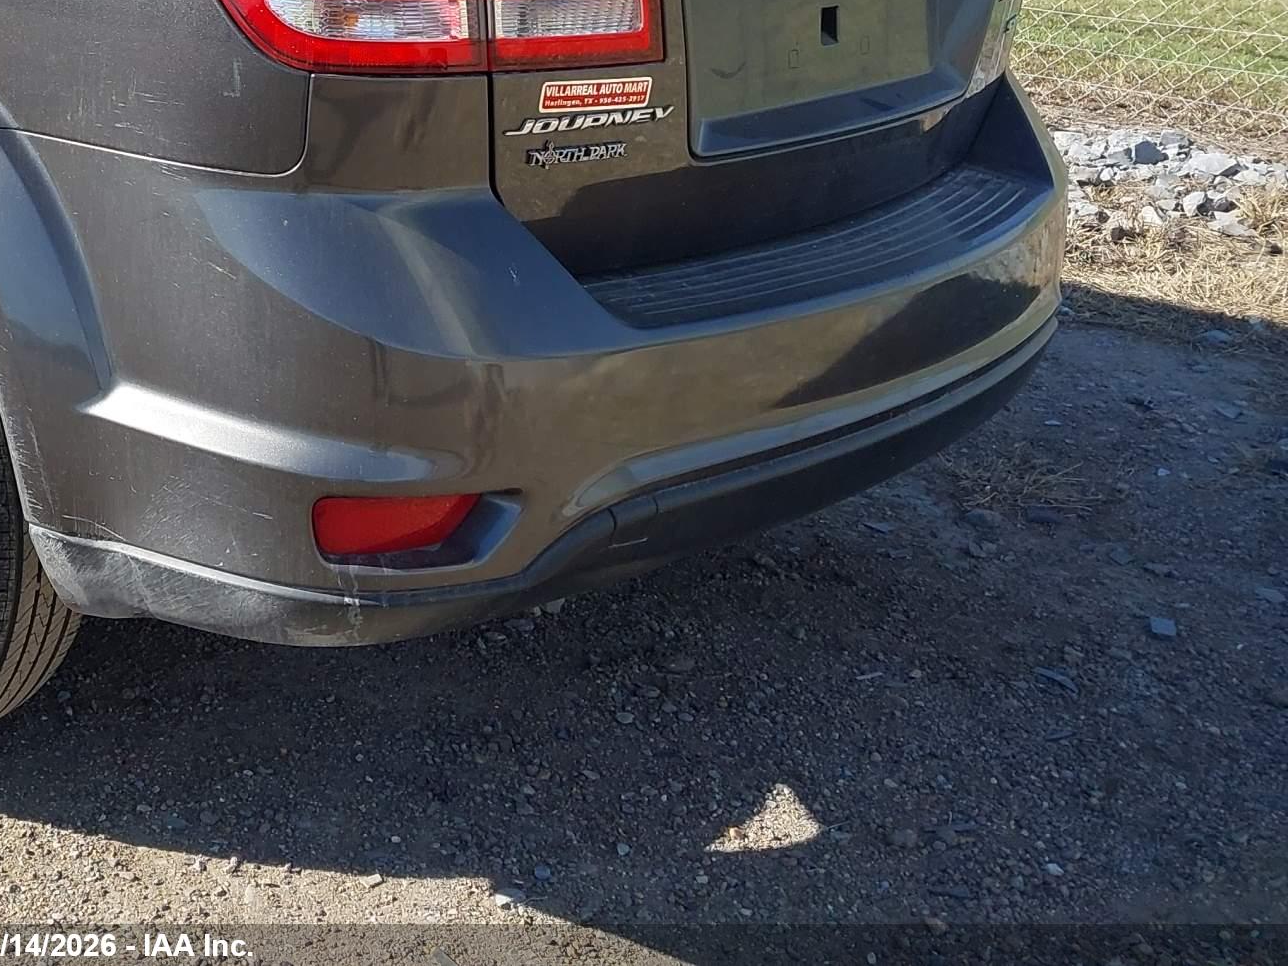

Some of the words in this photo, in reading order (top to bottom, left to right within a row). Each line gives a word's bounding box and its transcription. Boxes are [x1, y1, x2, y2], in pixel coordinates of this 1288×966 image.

[546, 85, 598, 97] VILLARREAL
[599, 83, 623, 95] AUTO
[624, 82, 649, 94] MART
[504, 106, 675, 136] JOURNEY
